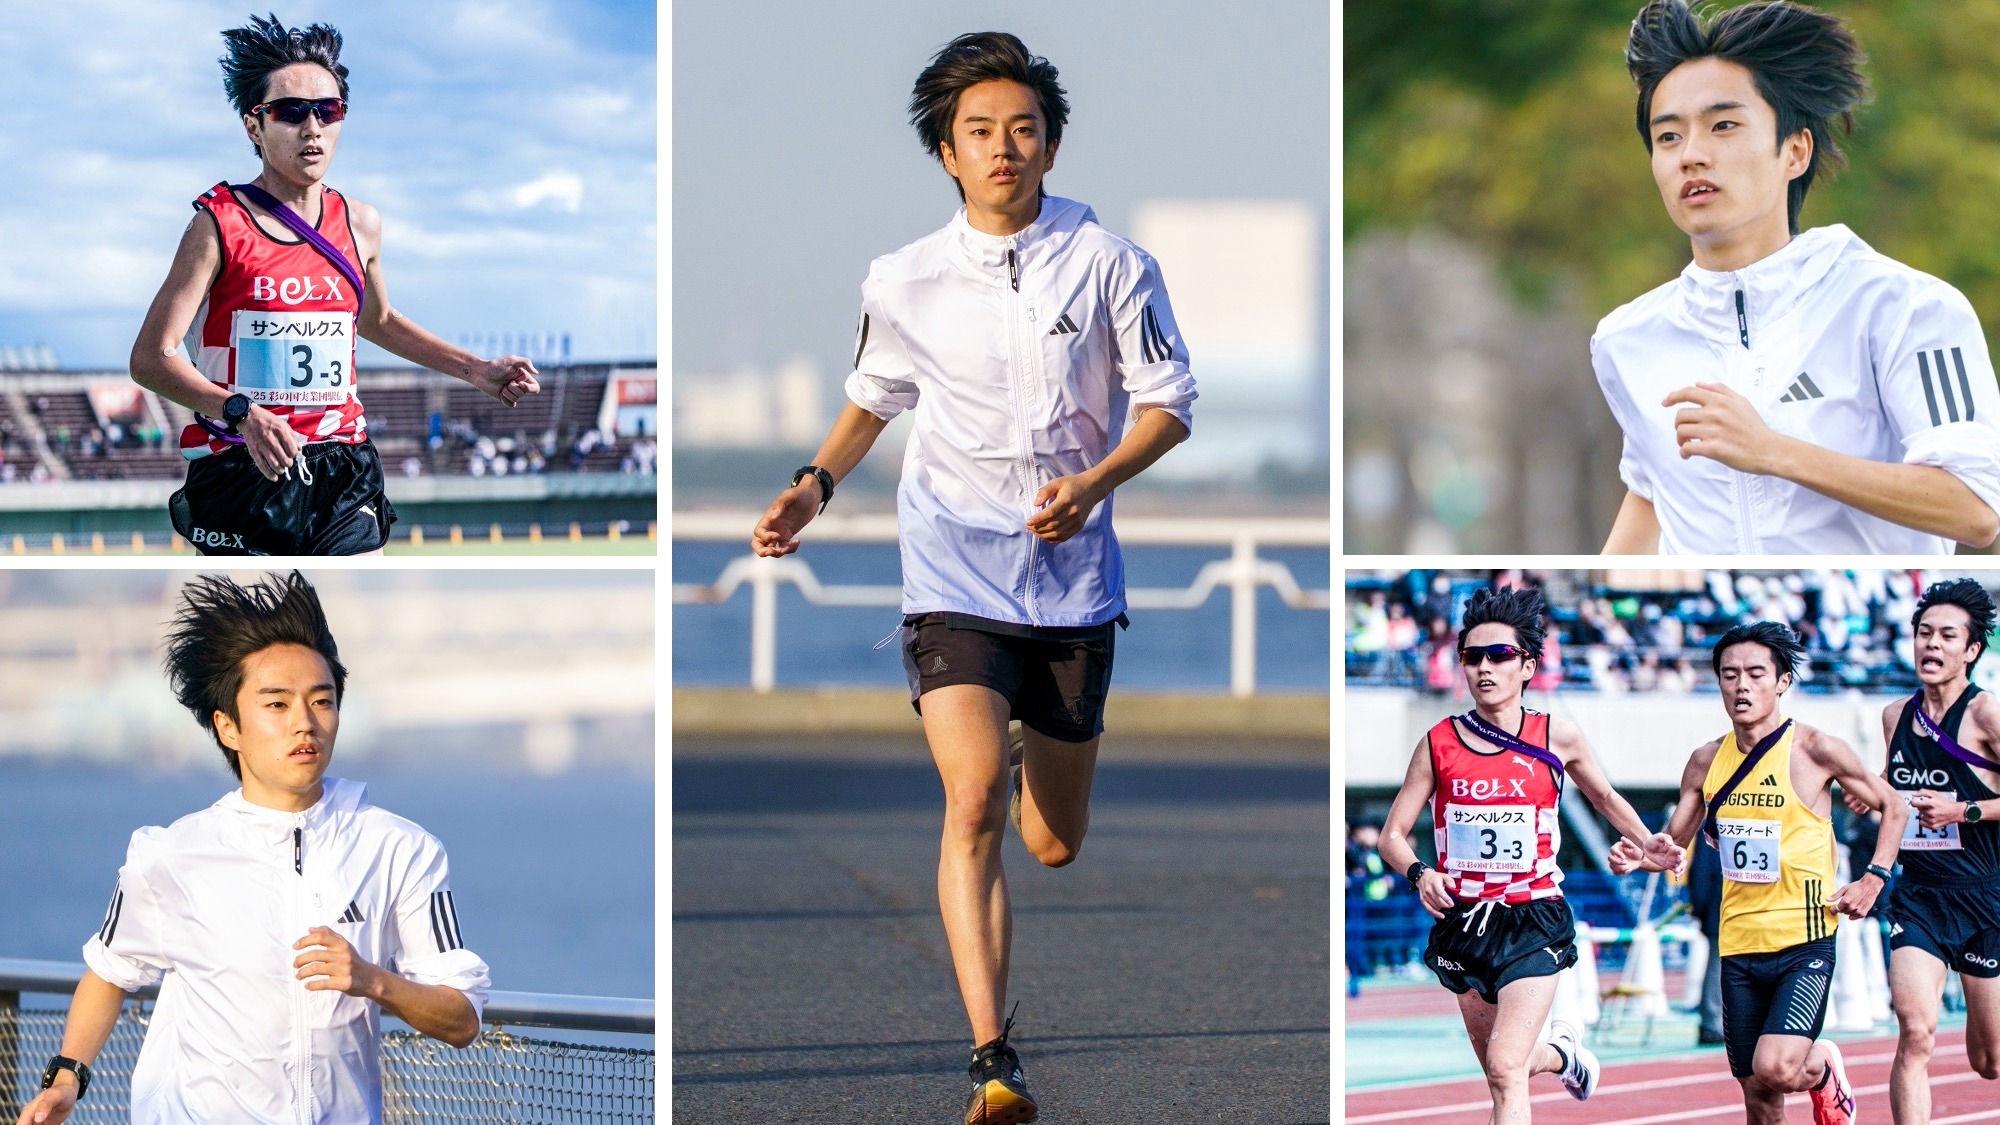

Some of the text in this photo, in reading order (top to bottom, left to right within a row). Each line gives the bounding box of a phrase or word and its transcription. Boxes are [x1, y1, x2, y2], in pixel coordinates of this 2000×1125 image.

[251, 320, 344, 336] サンベルクス
[1893, 767, 1950, 786] GMO
[1714, 792, 1785, 808] GISTEED
[1454, 811, 1525, 824] サンベルクス
[1716, 823, 1773, 837] ジスティード
[1964, 952, 1998, 969] GMO
